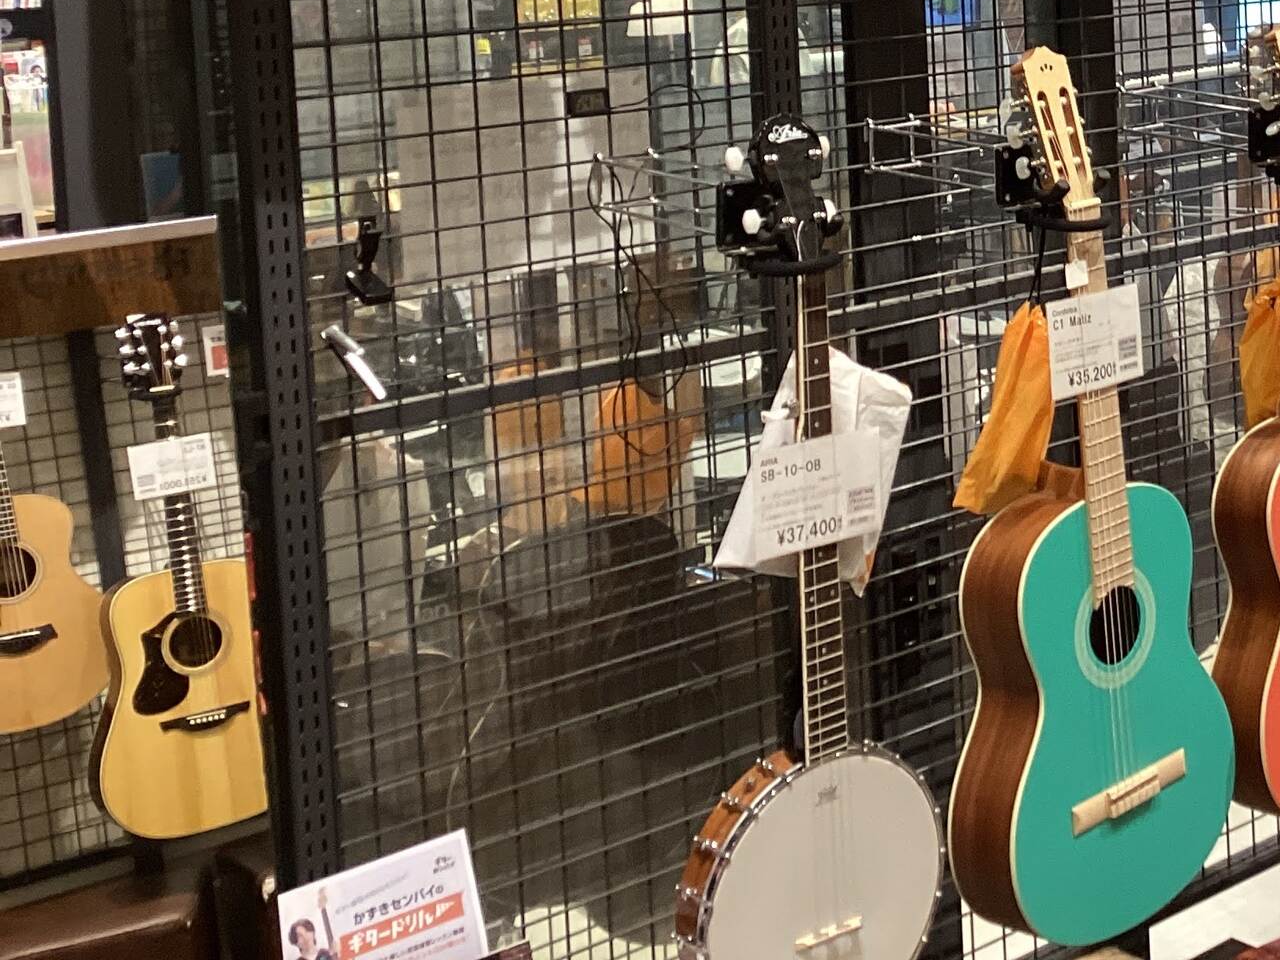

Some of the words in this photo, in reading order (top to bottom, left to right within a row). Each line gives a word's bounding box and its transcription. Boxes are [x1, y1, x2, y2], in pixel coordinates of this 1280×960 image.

[768, 124, 808, 144] Aria
[1053, 318, 1064, 331] C1
[1069, 313, 1092, 327] Matiz
[777, 517, 837, 546] ¥37,400
[348, 903, 433, 954] ギタードリル
